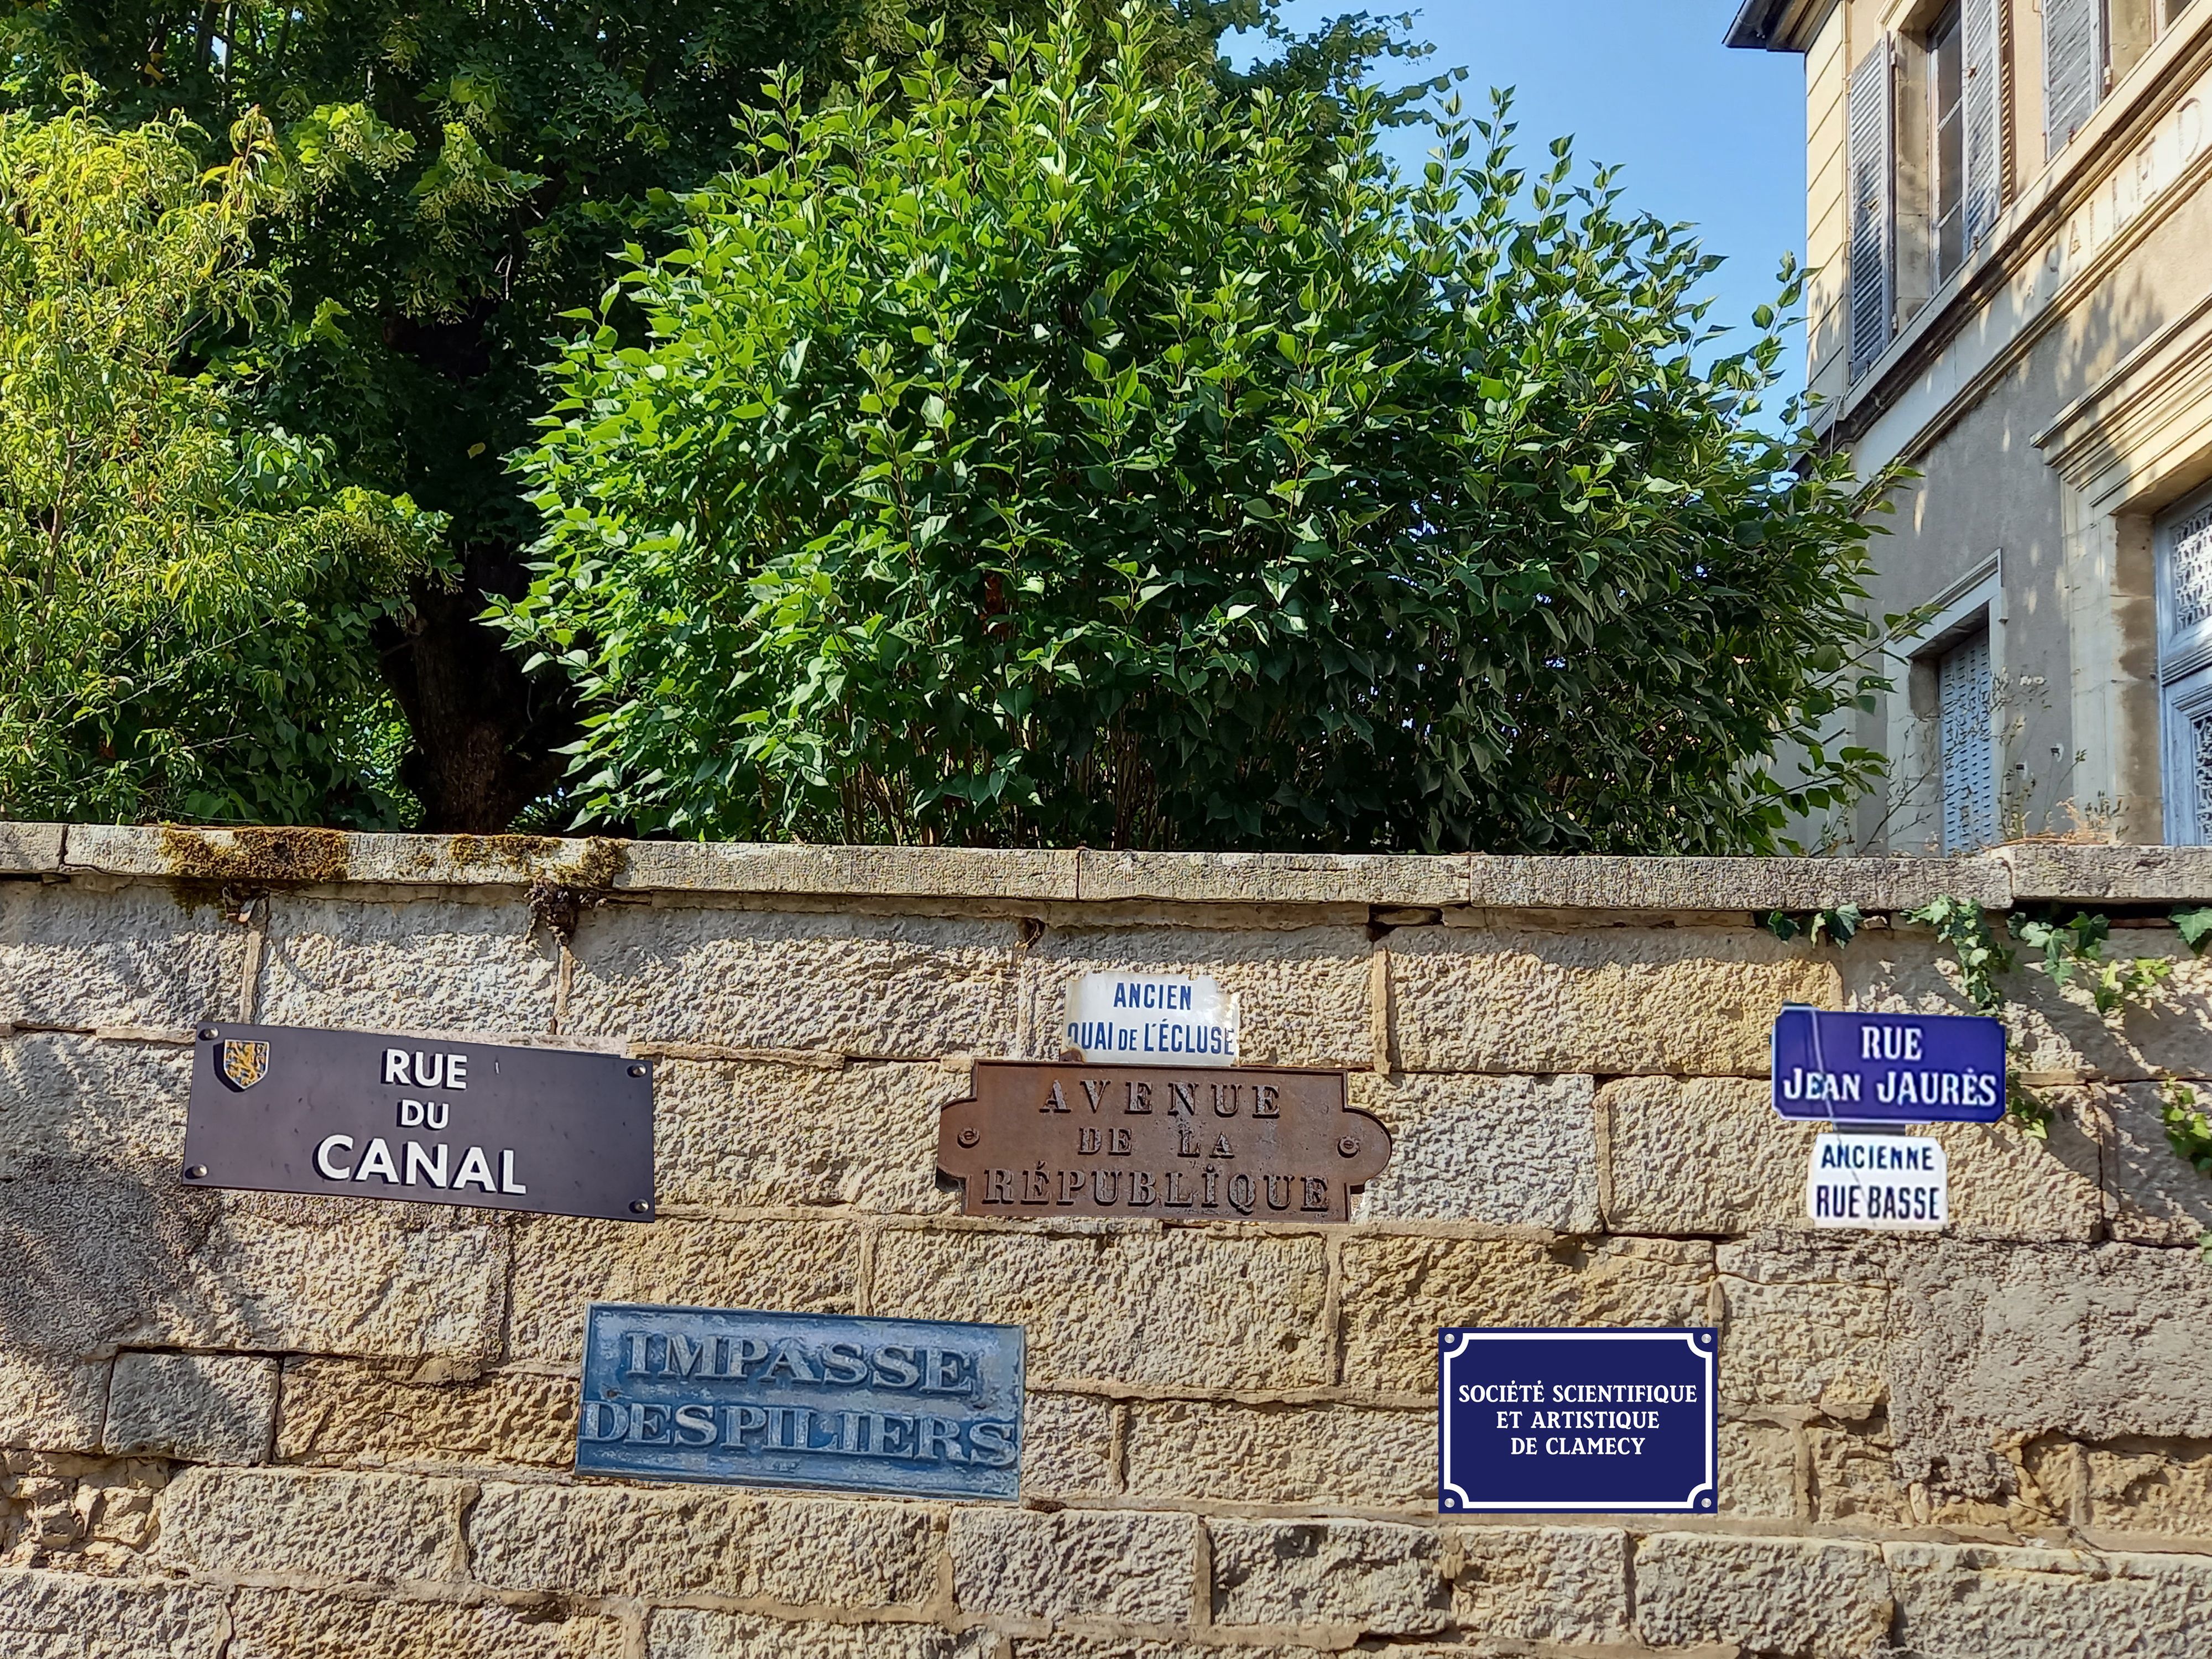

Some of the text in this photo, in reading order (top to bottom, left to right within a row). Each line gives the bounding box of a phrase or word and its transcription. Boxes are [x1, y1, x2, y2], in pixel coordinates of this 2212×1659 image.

[1113, 982, 1192, 1010] ANCIEN
[1861, 1026, 1923, 1060] RUE
[384, 1048, 468, 1089] RUE
[1040, 1079, 1281, 1119] AVENUE
[1782, 1067, 1996, 1107] JEAN JAURÈS
[399, 1099, 449, 1130] DU
[1077, 1126, 1235, 1159] DE LA
[1821, 1144, 1935, 1171] ANCIENNE
[315, 1135, 527, 1195] CANAL
[982, 1160, 1328, 1213] RÉPUBLIQUE
[1817, 1185, 1940, 1220] RUE BASSE
[625, 1331, 978, 1395] IMPASSE
[1458, 1380, 1698, 1404] SOCIÉTÉ SCIENTIFIQUE
[1496, 1411, 1660, 1430] ET ARTISTIQUE
[1510, 1437, 1646, 1455] DE CLAMECY
